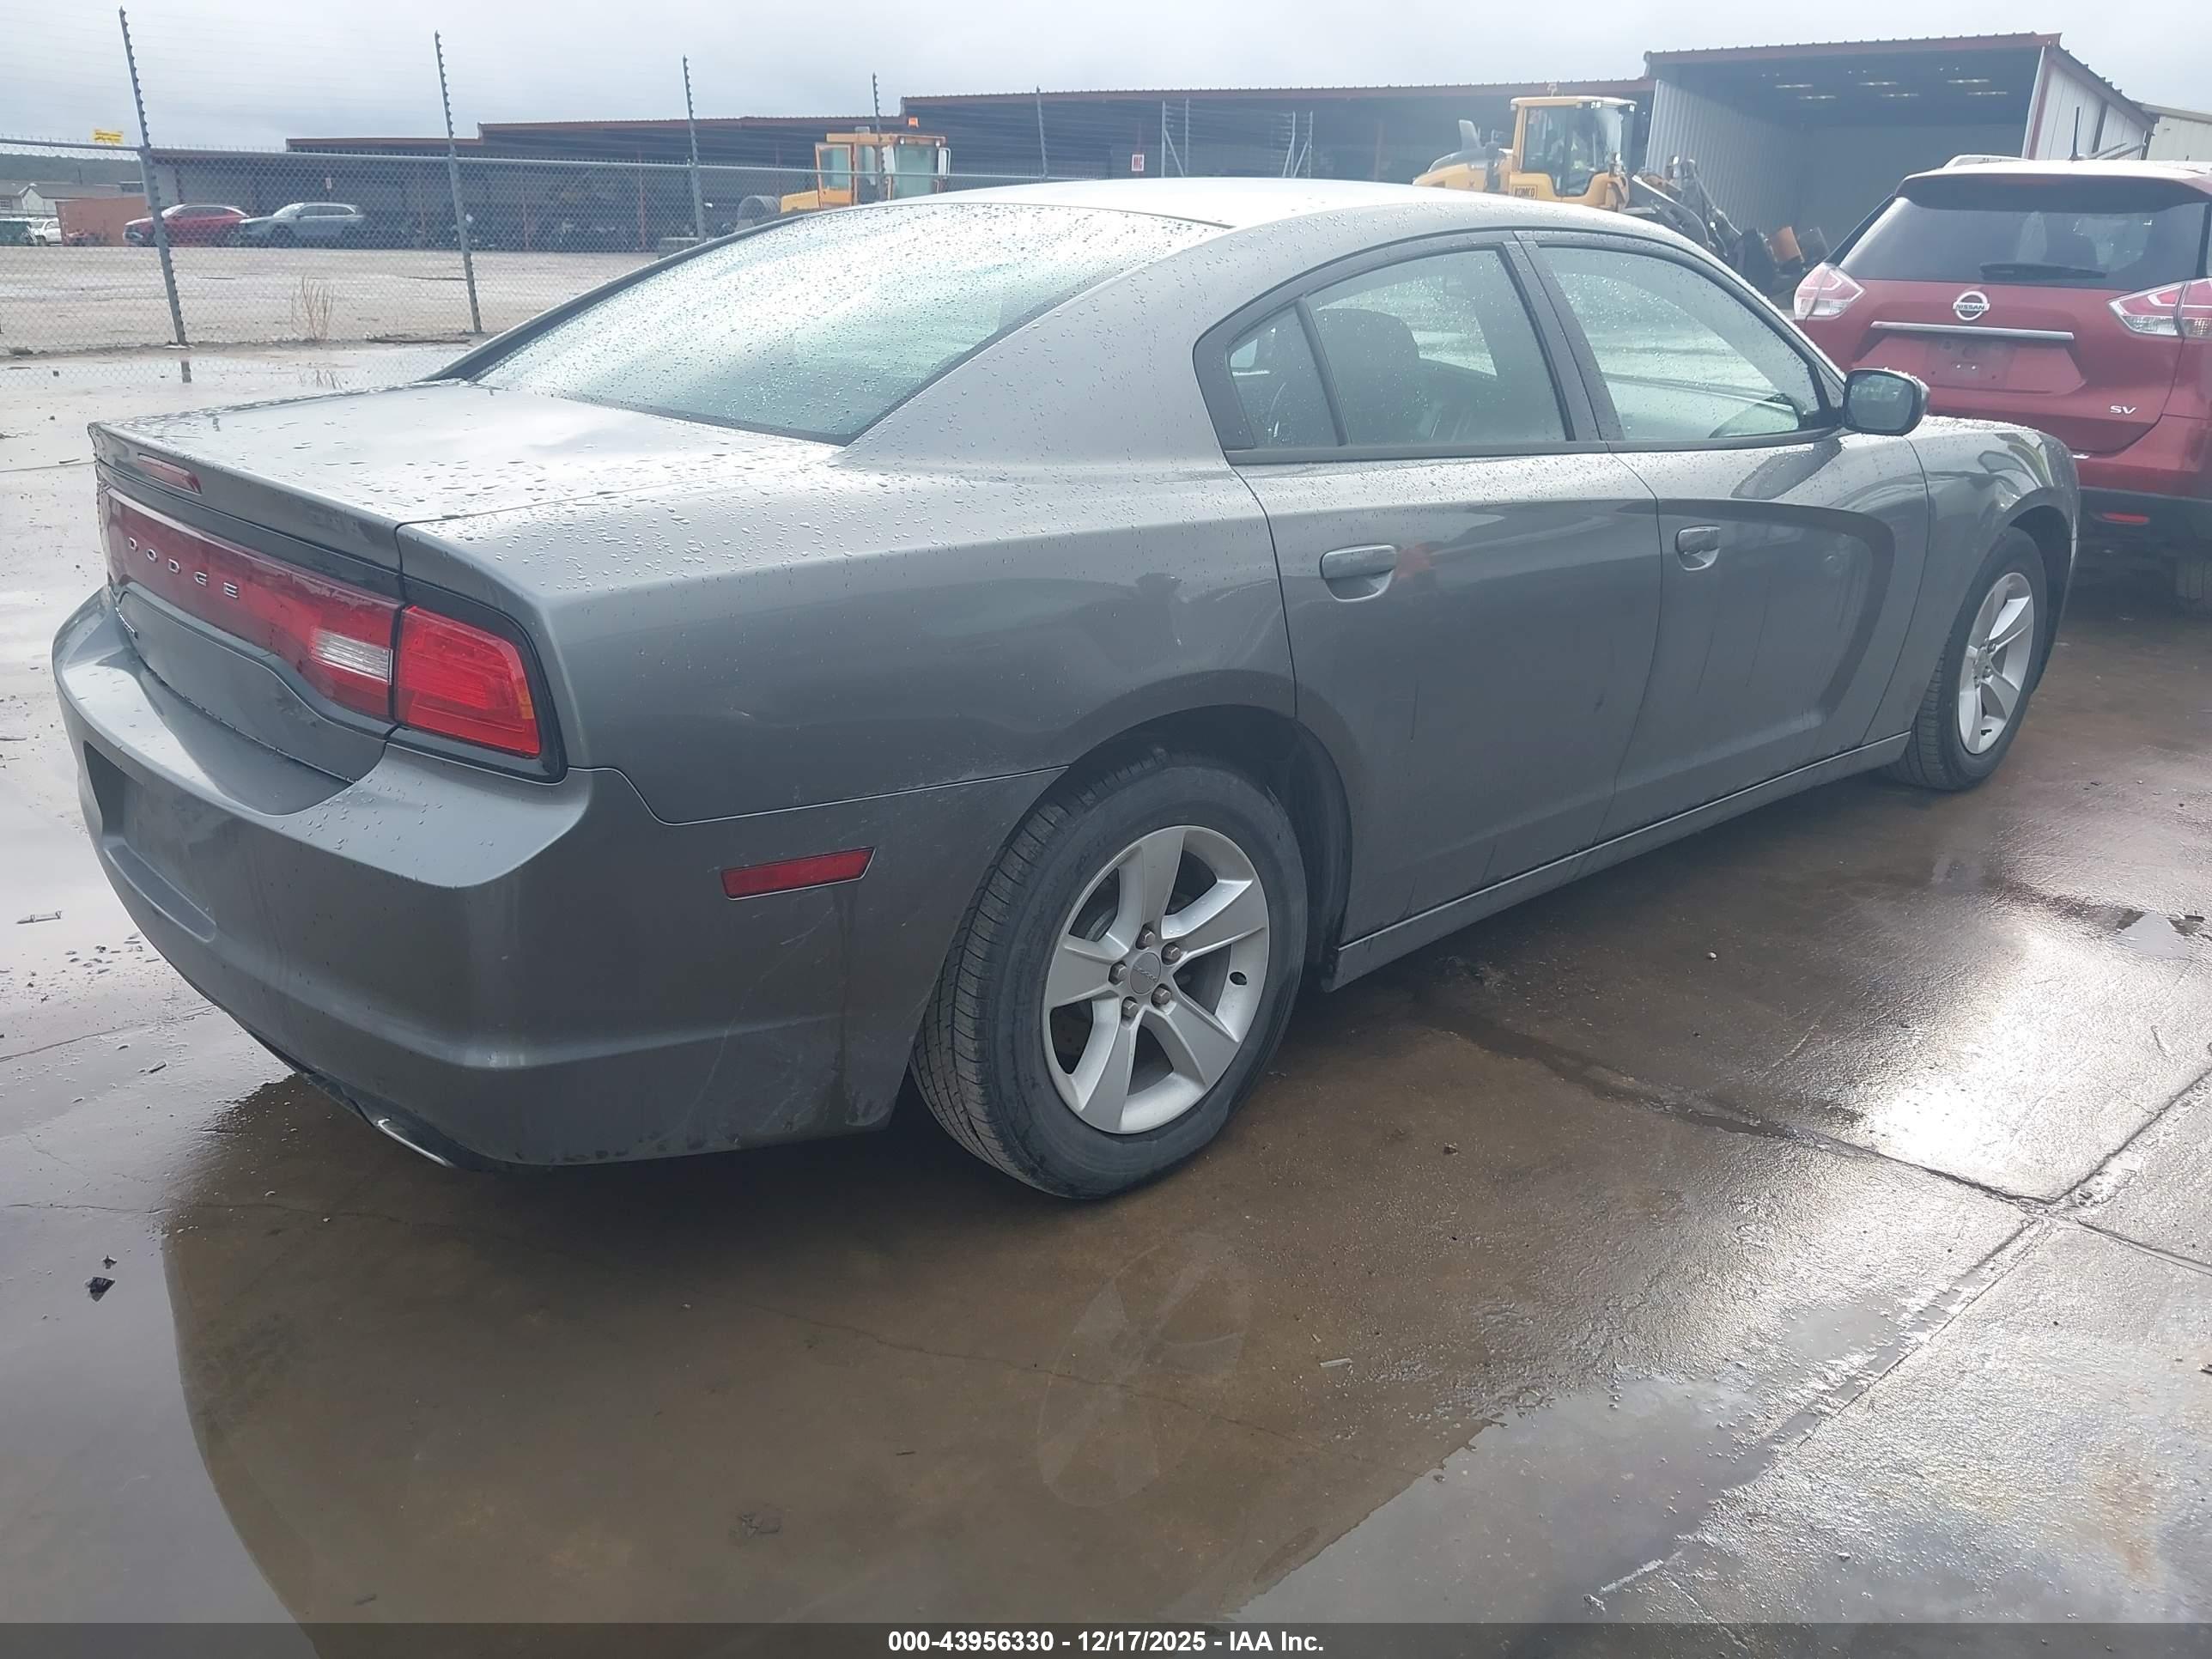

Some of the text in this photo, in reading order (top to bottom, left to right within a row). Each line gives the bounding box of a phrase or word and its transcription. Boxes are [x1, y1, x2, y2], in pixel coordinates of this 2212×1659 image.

[1955, 302, 1985, 311] NISSAN
[2110, 405, 2137, 414] SV
[128, 536, 239, 599] DODGE
